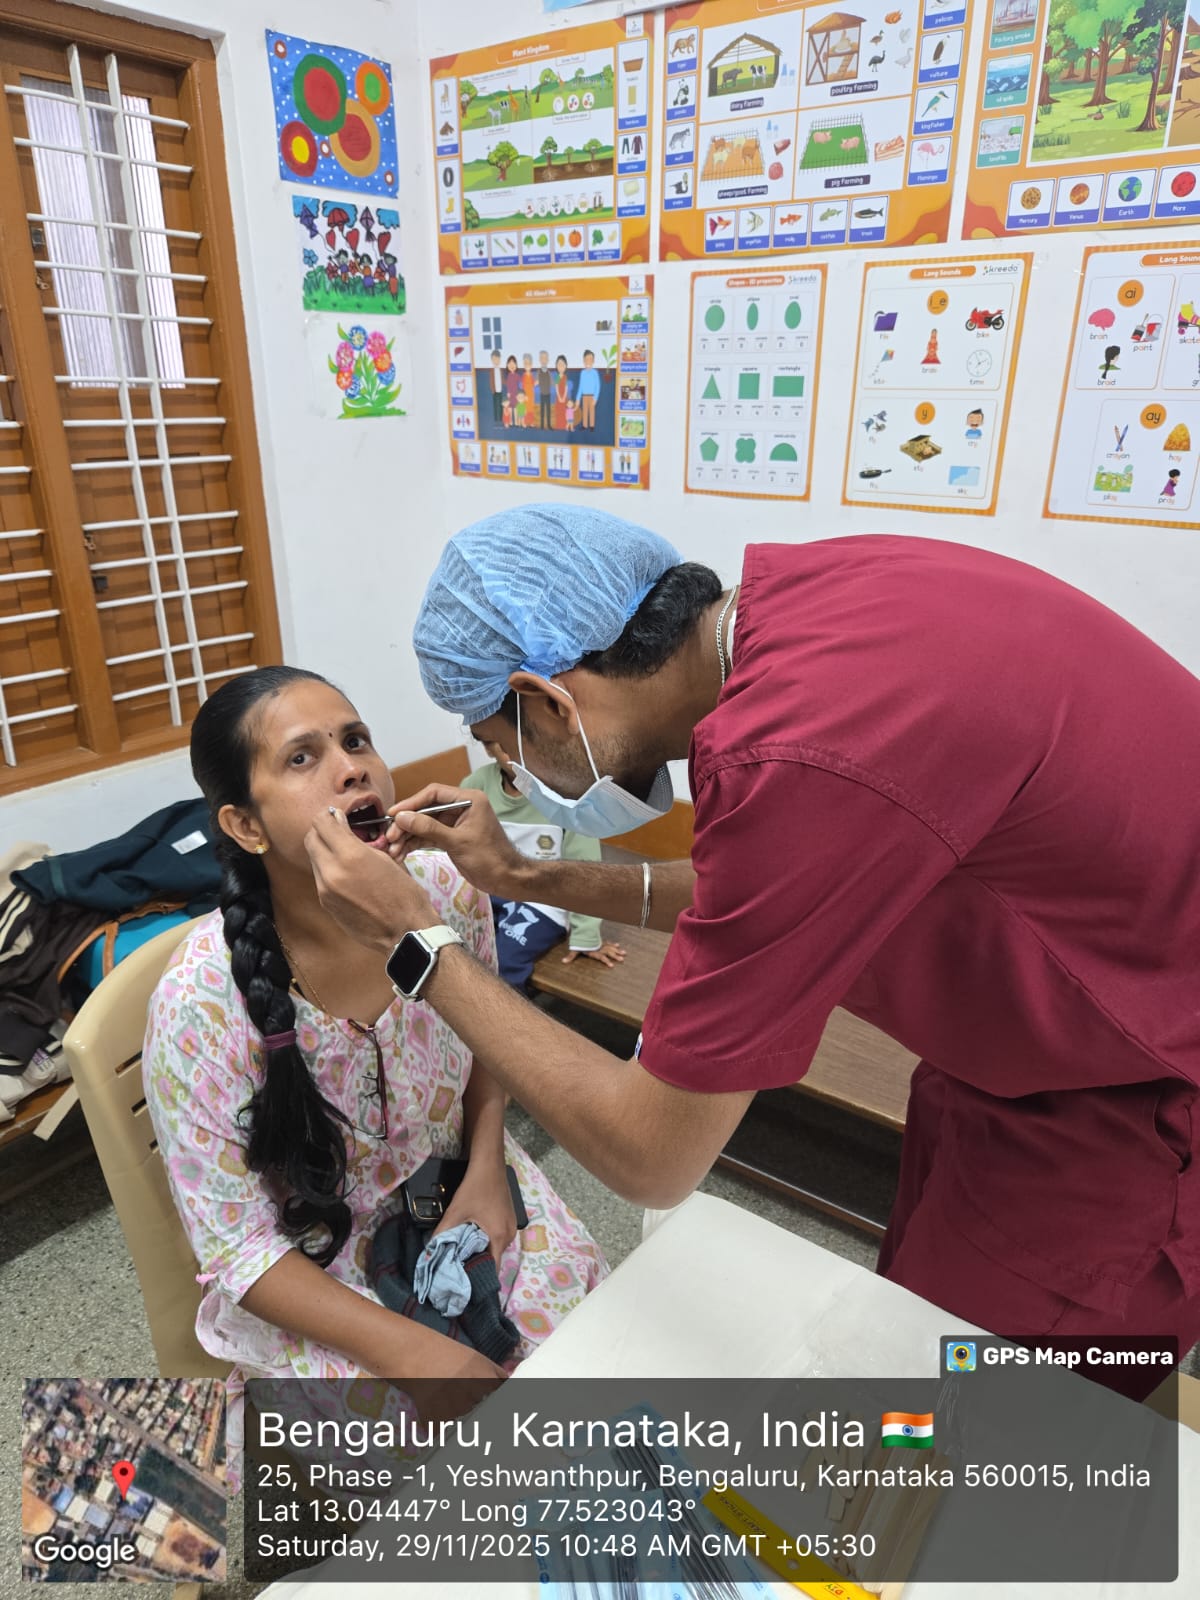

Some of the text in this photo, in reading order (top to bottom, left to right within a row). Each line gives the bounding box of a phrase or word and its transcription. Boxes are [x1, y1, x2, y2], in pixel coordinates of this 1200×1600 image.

[1160, 256, 1178, 264] Long
[923, 268, 962, 279] Long Sounds
[1125, 288, 1137, 299] ai
[1145, 412, 1162, 424] ay
